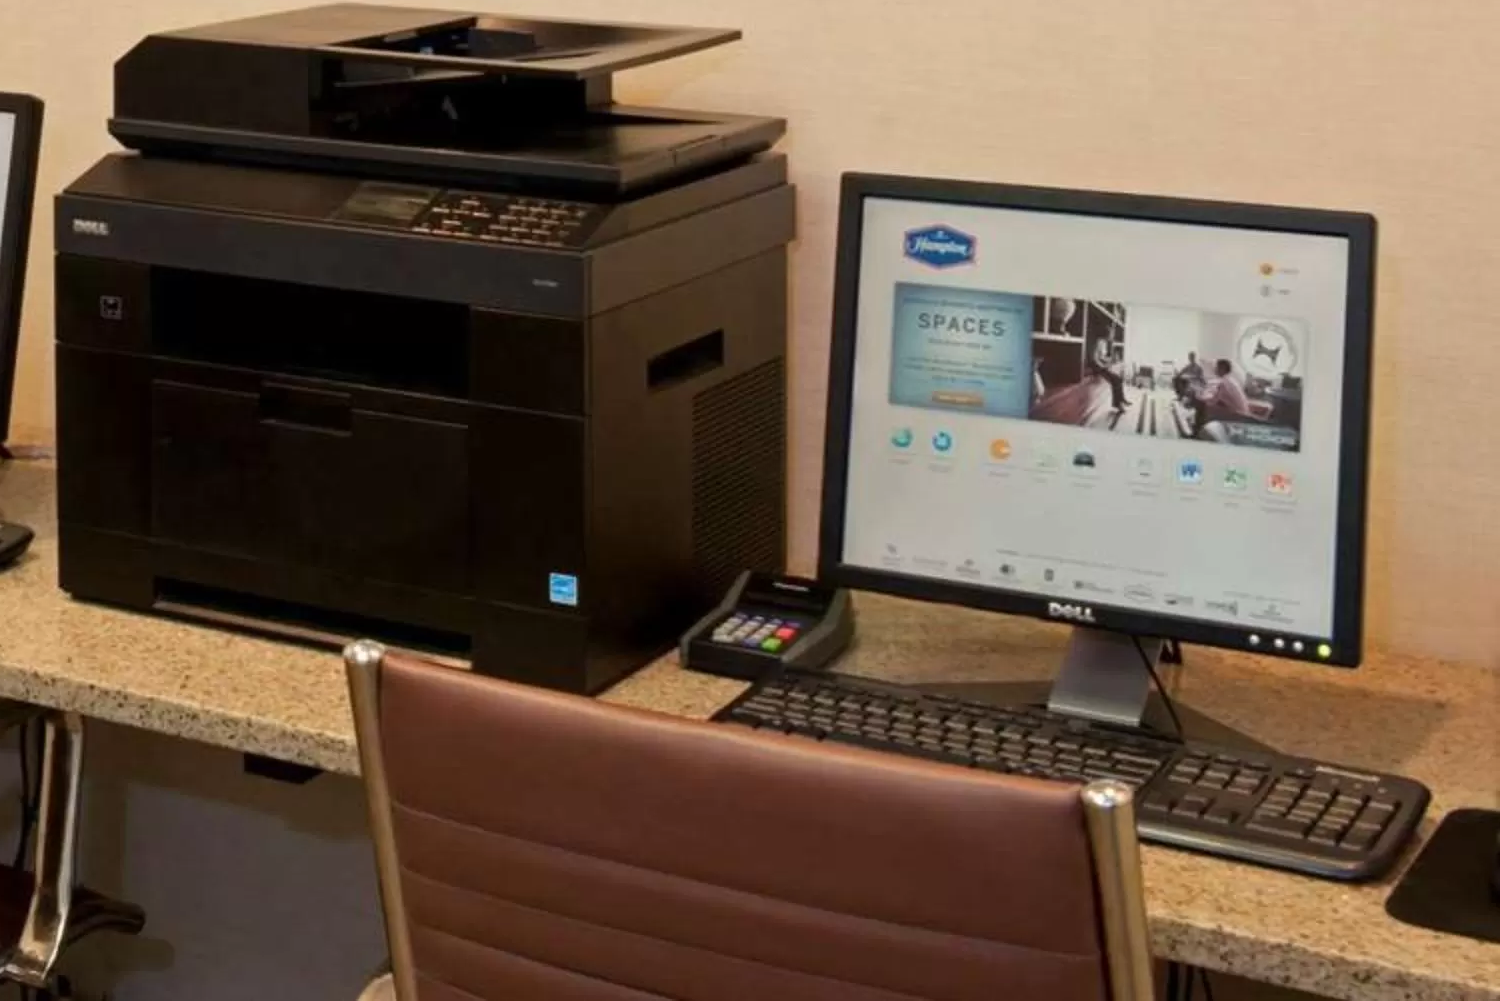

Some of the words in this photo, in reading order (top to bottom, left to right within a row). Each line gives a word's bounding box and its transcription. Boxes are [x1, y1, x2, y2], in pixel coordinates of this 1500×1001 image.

[908, 233, 971, 257] Hampton
[917, 312, 1006, 337] SPACES
[1048, 601, 1095, 622] DELL
